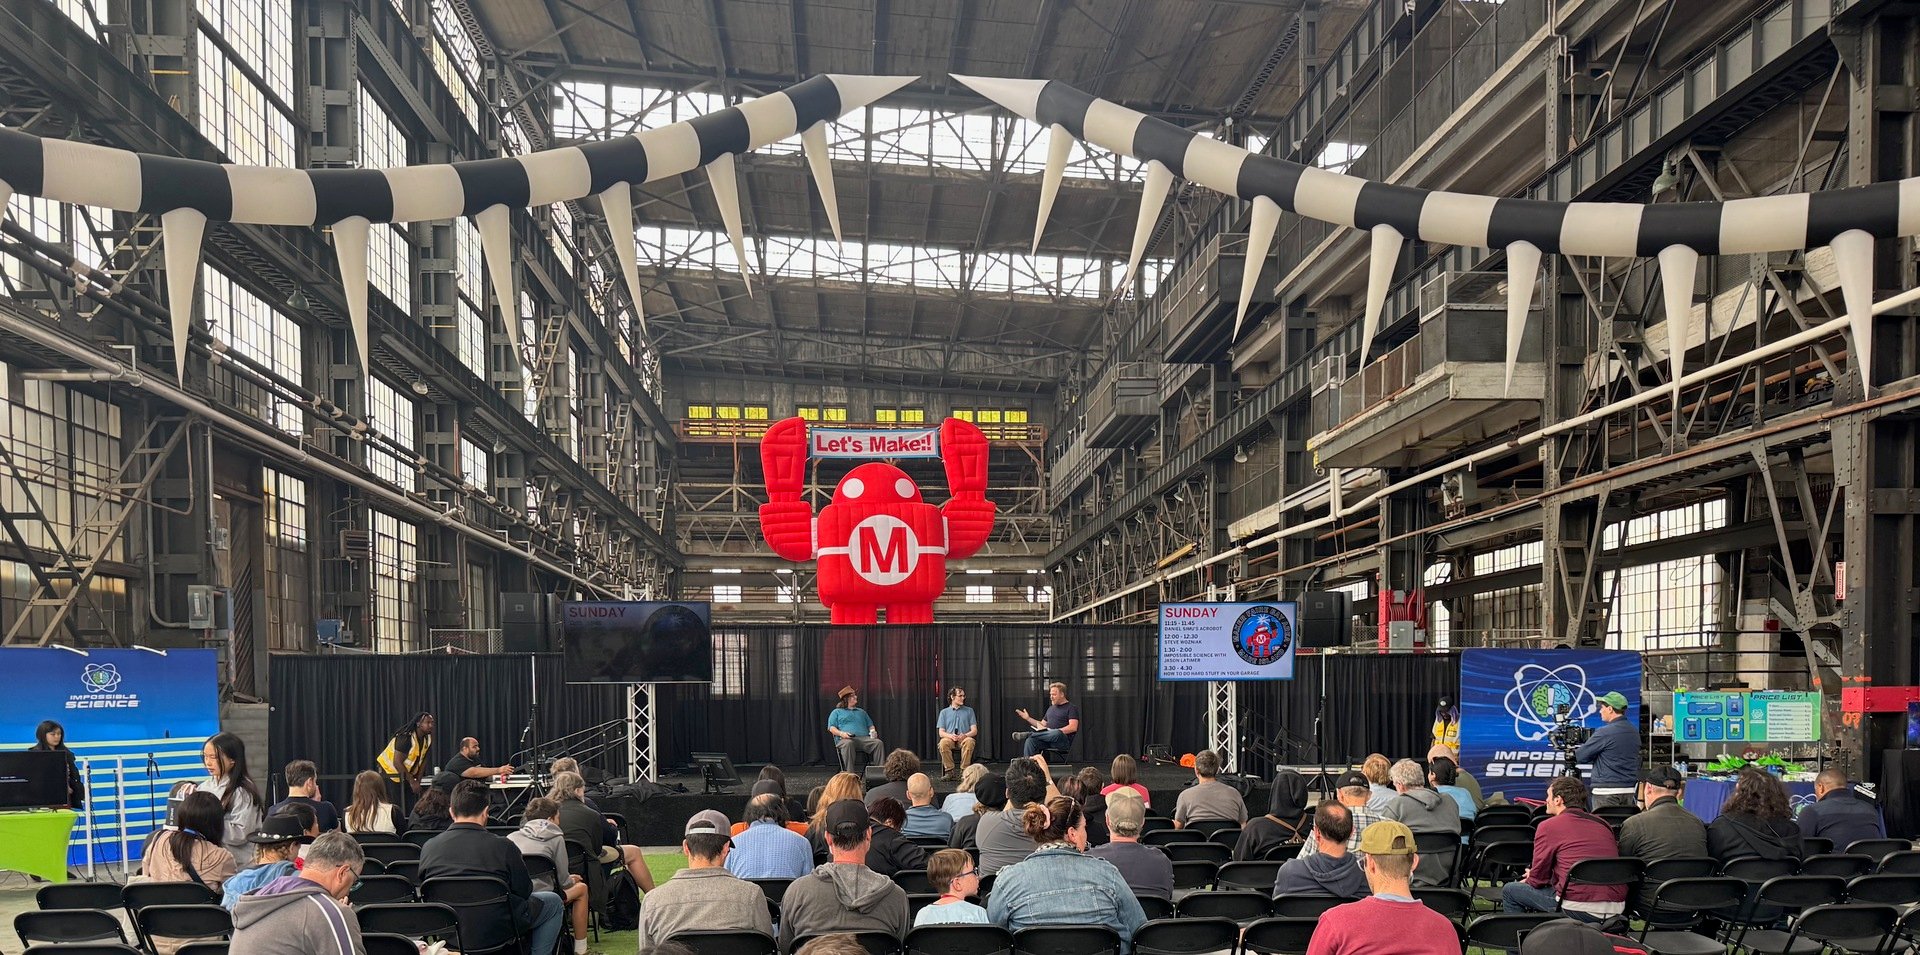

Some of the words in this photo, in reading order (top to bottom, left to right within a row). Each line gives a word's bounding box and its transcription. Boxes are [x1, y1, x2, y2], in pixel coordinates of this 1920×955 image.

[816, 435, 863, 453] Let's
[859, 527, 909, 574] M
[569, 607, 626, 618] SUNDAY
[1165, 607, 1218, 618] SUNDAY
[1233, 614, 1247, 643] MAKER
[1246, 606, 1269, 617] FAIRE
[1269, 607, 1285, 621] BAY
[65, 700, 139, 709] SCIENCE
[1494, 750, 1565, 761] IMPOSS
[1485, 762, 1593, 777] SCIENC
